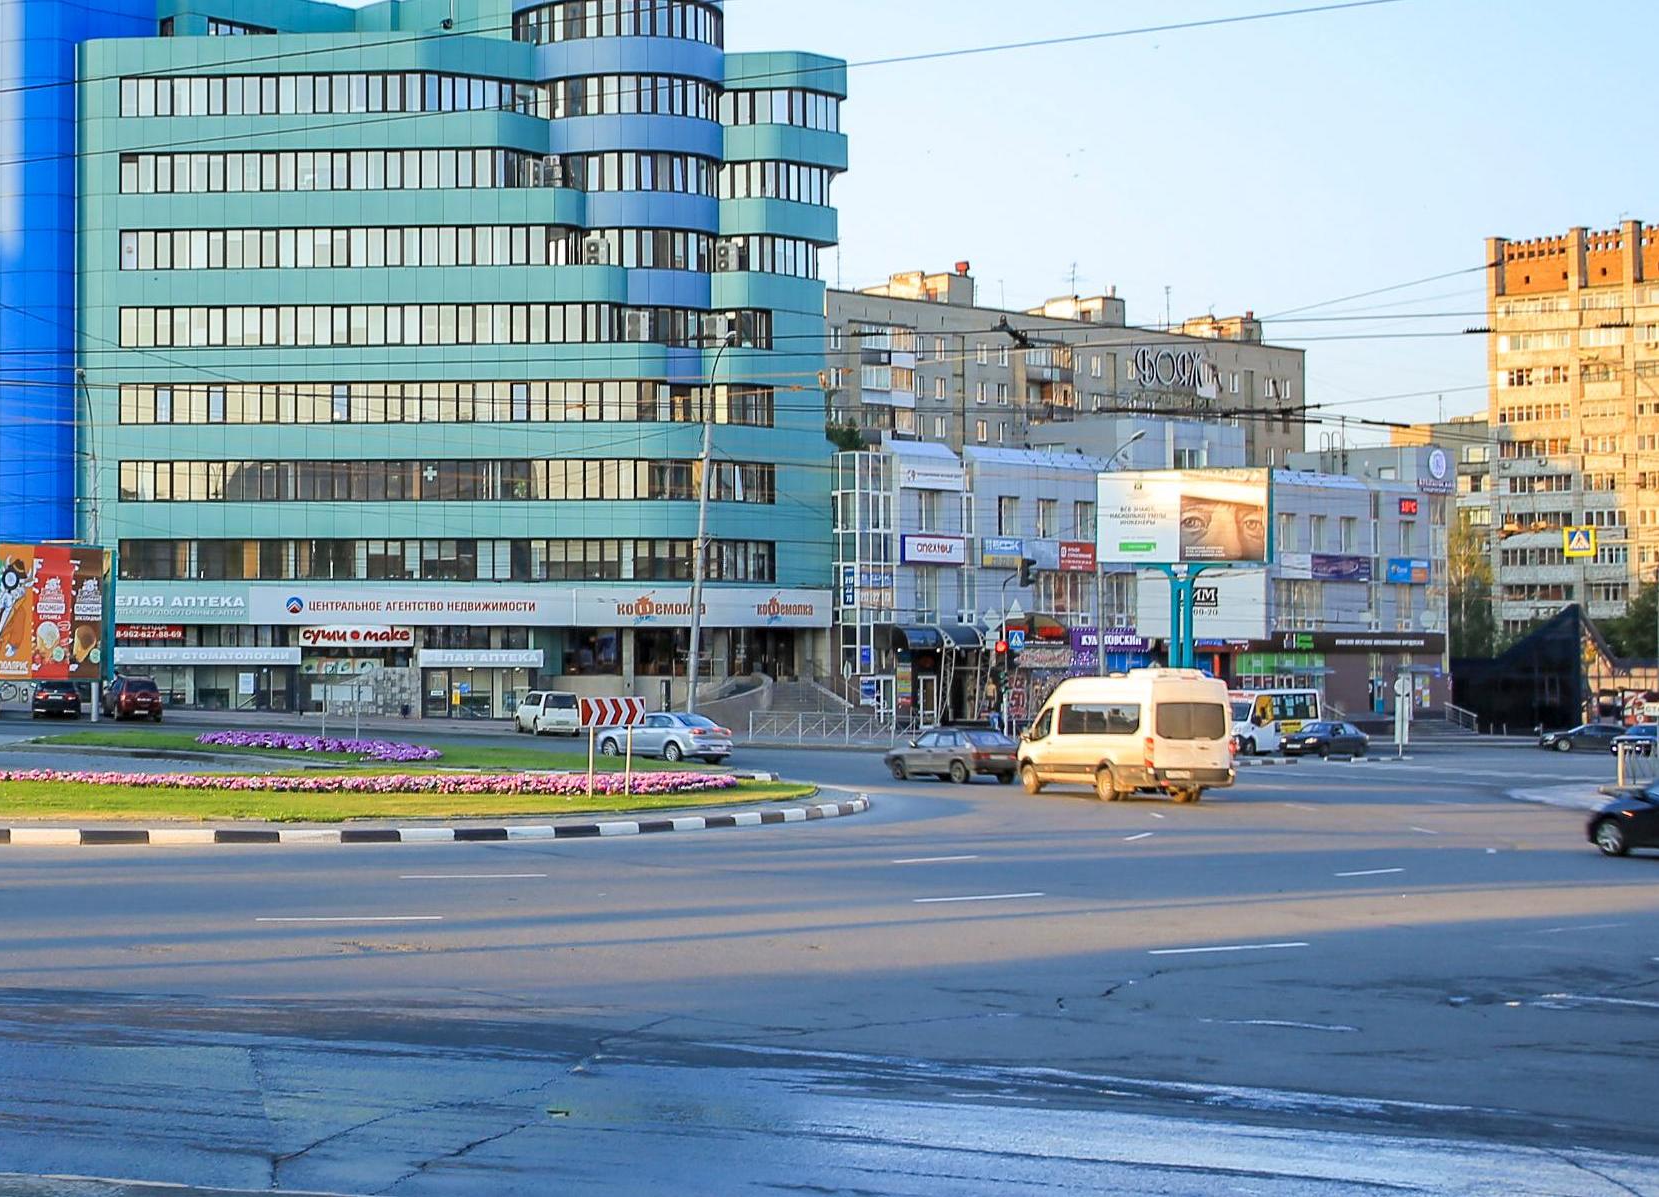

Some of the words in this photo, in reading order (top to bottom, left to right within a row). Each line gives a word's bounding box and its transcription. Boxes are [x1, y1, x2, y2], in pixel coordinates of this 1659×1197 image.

[1136, 347, 1202, 387] ВОЯЖ
[116, 595, 164, 608] ЕЛАЯ
[171, 595, 245, 608] АПТЕКА
[308, 601, 382, 612] ЦЕНТРАЛЬНОЕ
[385, 601, 444, 612] АГЕНТСТВО
[447, 601, 536, 613] НЕДВИЖИМОСТИ
[38, 604, 65, 613] ПЛОМБИР
[136, 608, 216, 618] КРУГЛОСУТОЧНЫХ
[217, 608, 245, 617] АПТЕК
[302, 627, 347, 645] суши
[134, 652, 177, 661] ЦЕНТР
[182, 652, 290, 661] СТОМАТОЛОГИИ
[478, 652, 539, 662] АПТЕКА
